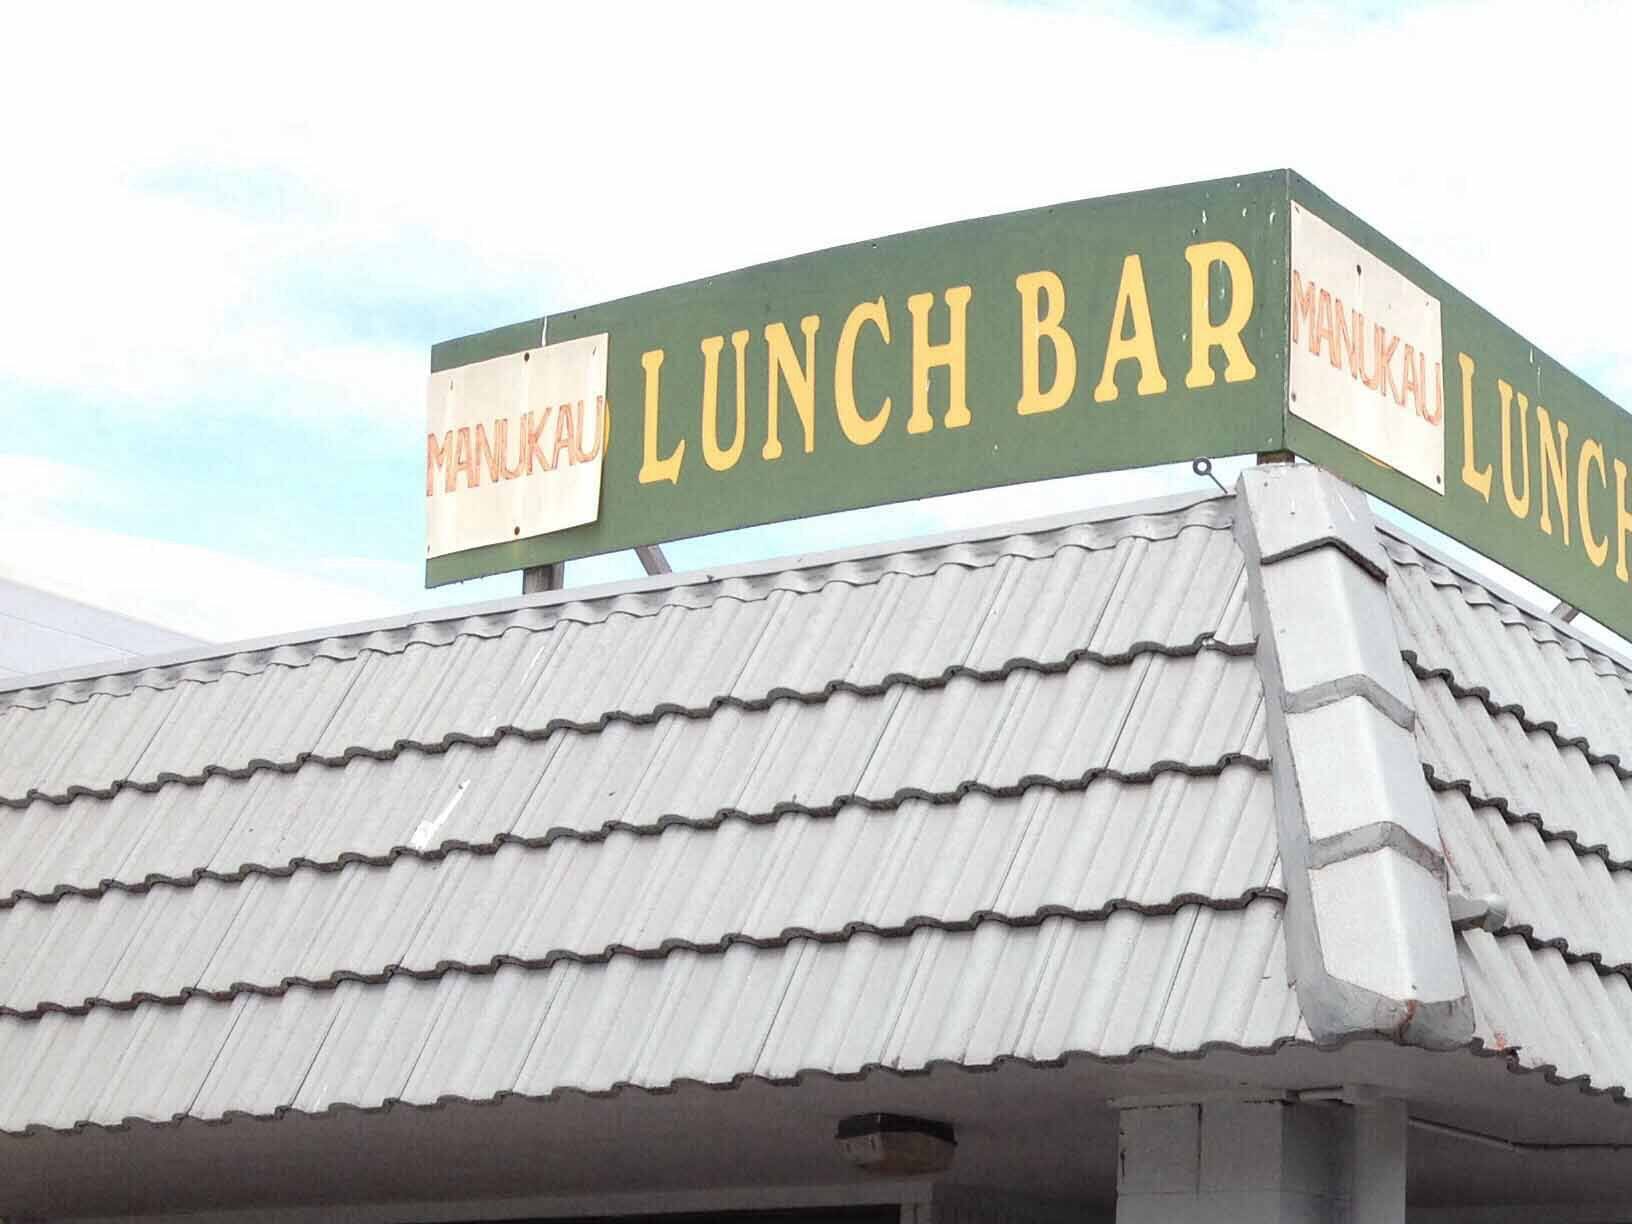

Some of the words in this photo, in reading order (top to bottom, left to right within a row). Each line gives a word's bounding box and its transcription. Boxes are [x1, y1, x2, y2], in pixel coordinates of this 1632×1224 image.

[638, 284, 972, 485] LUNCH
[1016, 239, 1256, 416] BAR
[1292, 270, 1443, 426] MANUKAU
[426, 394, 604, 497] MANUKAU
